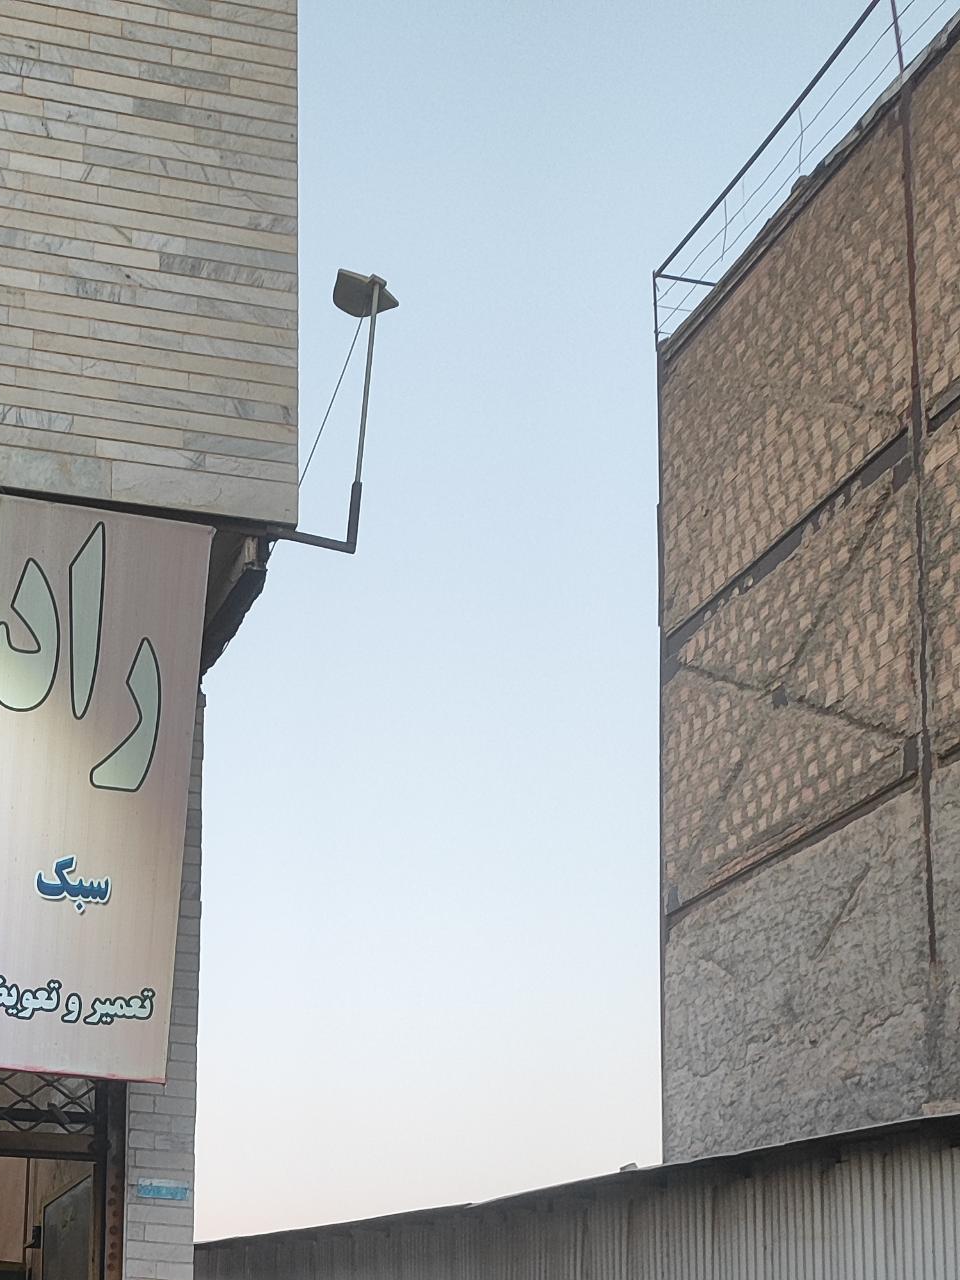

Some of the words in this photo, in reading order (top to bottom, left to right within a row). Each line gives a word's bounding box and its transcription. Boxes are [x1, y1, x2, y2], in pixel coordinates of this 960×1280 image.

[35, 855, 113, 917] سبک
[64, 990, 83, 1022] و
[83, 985, 156, 1025] تعمیر
